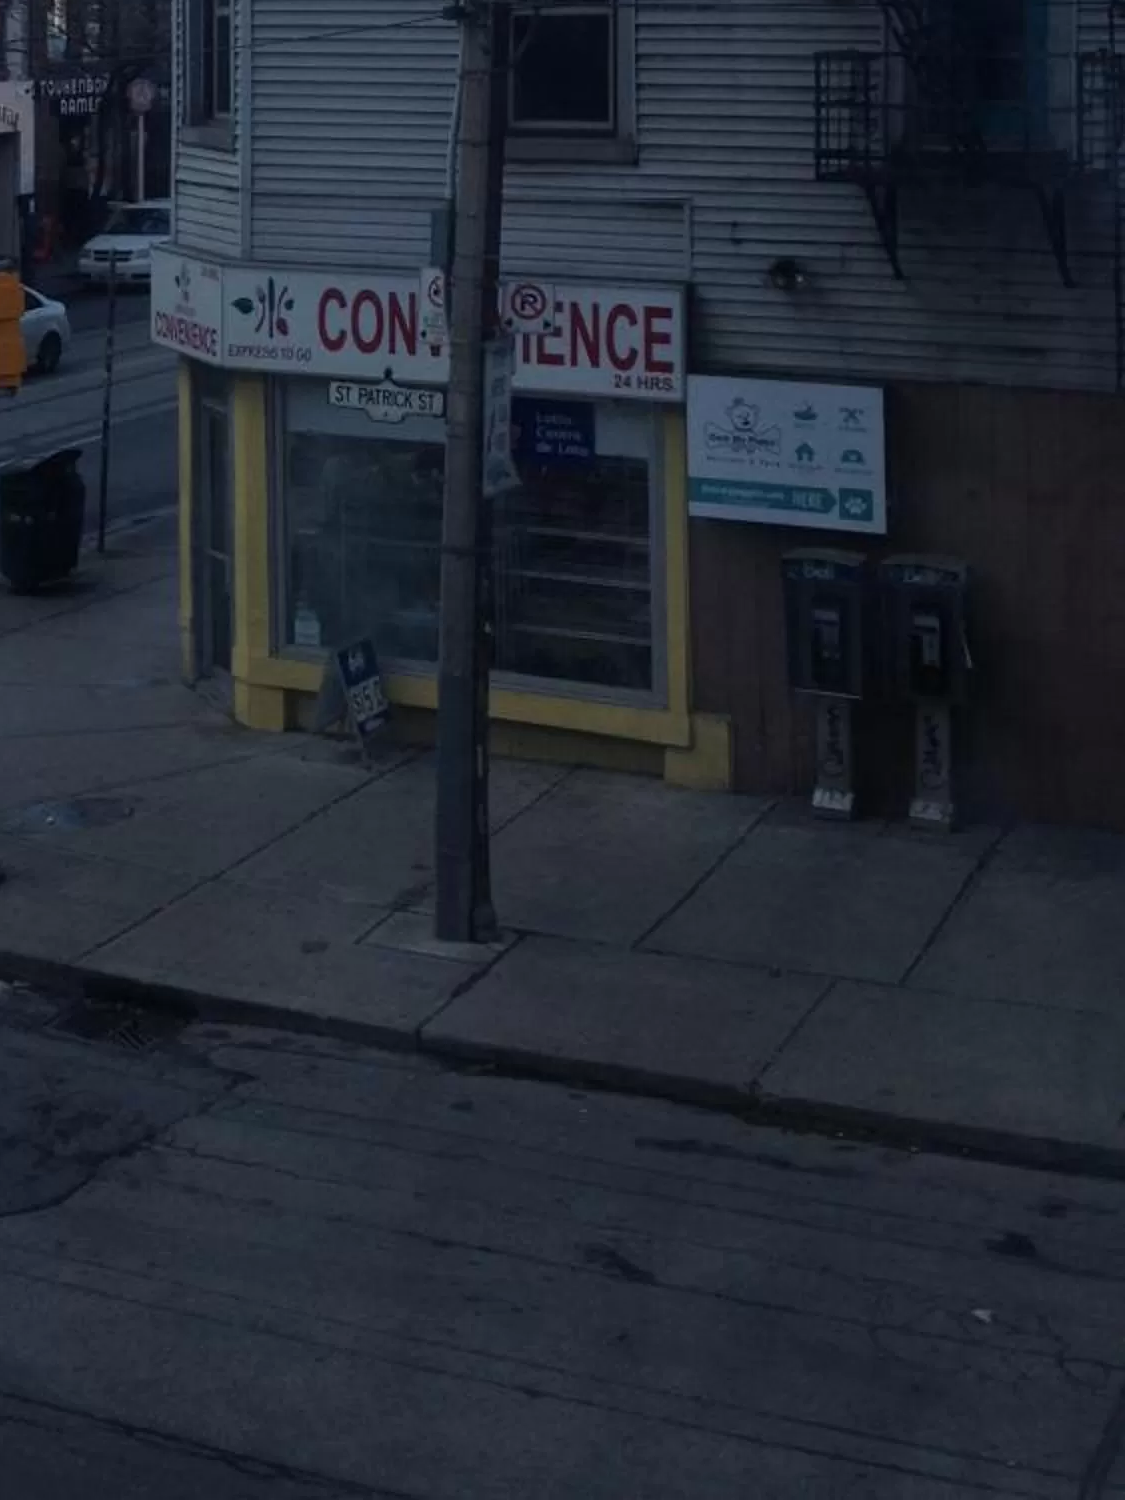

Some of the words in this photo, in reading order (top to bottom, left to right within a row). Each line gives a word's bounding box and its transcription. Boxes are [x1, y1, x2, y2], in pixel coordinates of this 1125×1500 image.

[318, 287, 674, 375] CONENCE
[614, 374, 632, 389] 24
[637, 375, 674, 391] HRS
[335, 386, 351, 404] ST
[358, 387, 414, 409] PATRICK
[418, 391, 435, 412] ST
